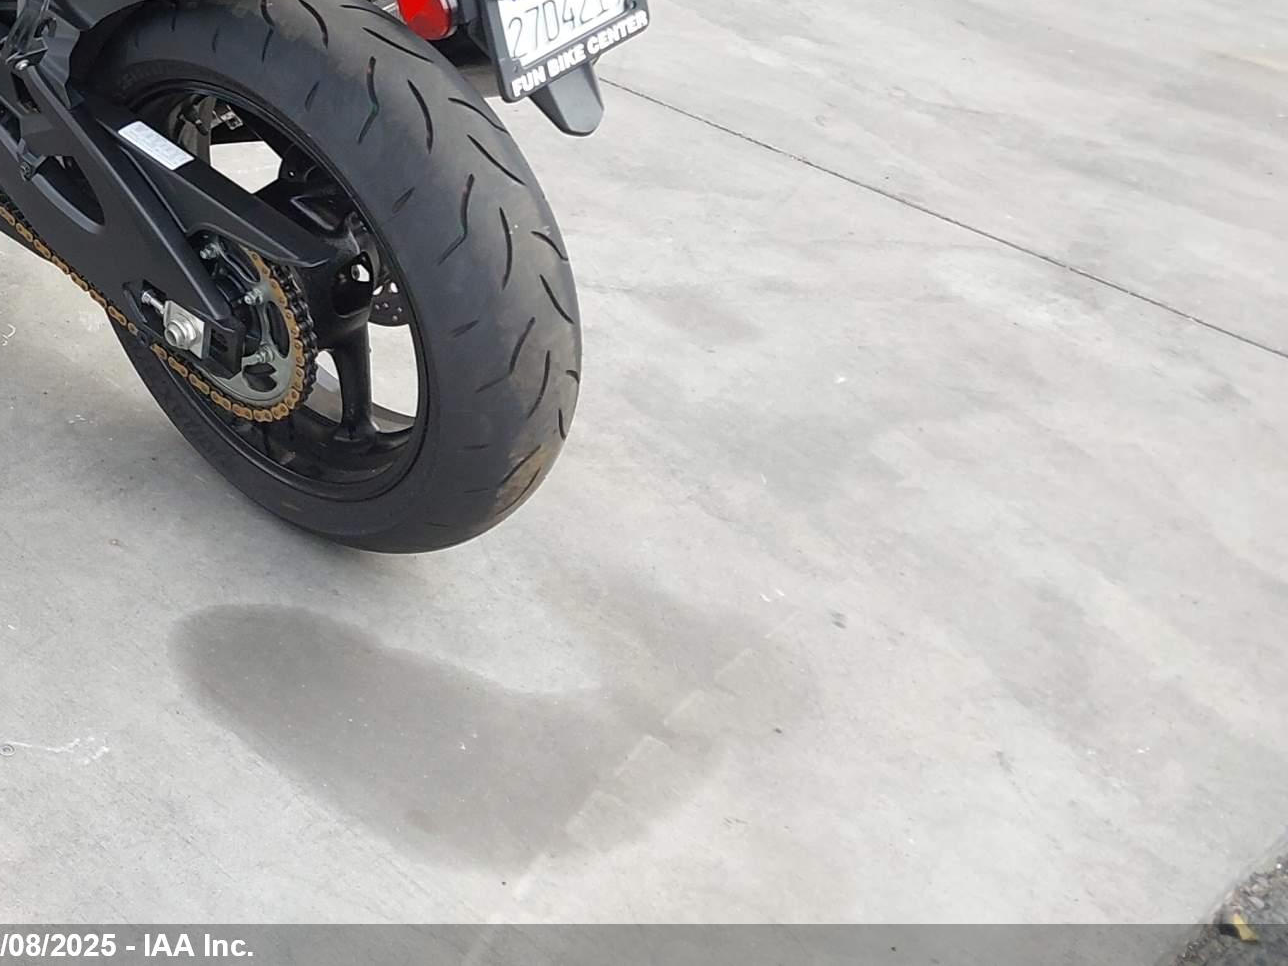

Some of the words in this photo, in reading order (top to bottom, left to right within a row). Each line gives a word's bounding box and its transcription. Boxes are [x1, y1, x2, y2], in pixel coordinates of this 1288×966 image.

[511, 66, 547, 97] FUN
[547, 43, 587, 78] BIKE
[586, 10, 649, 55] CENTER
